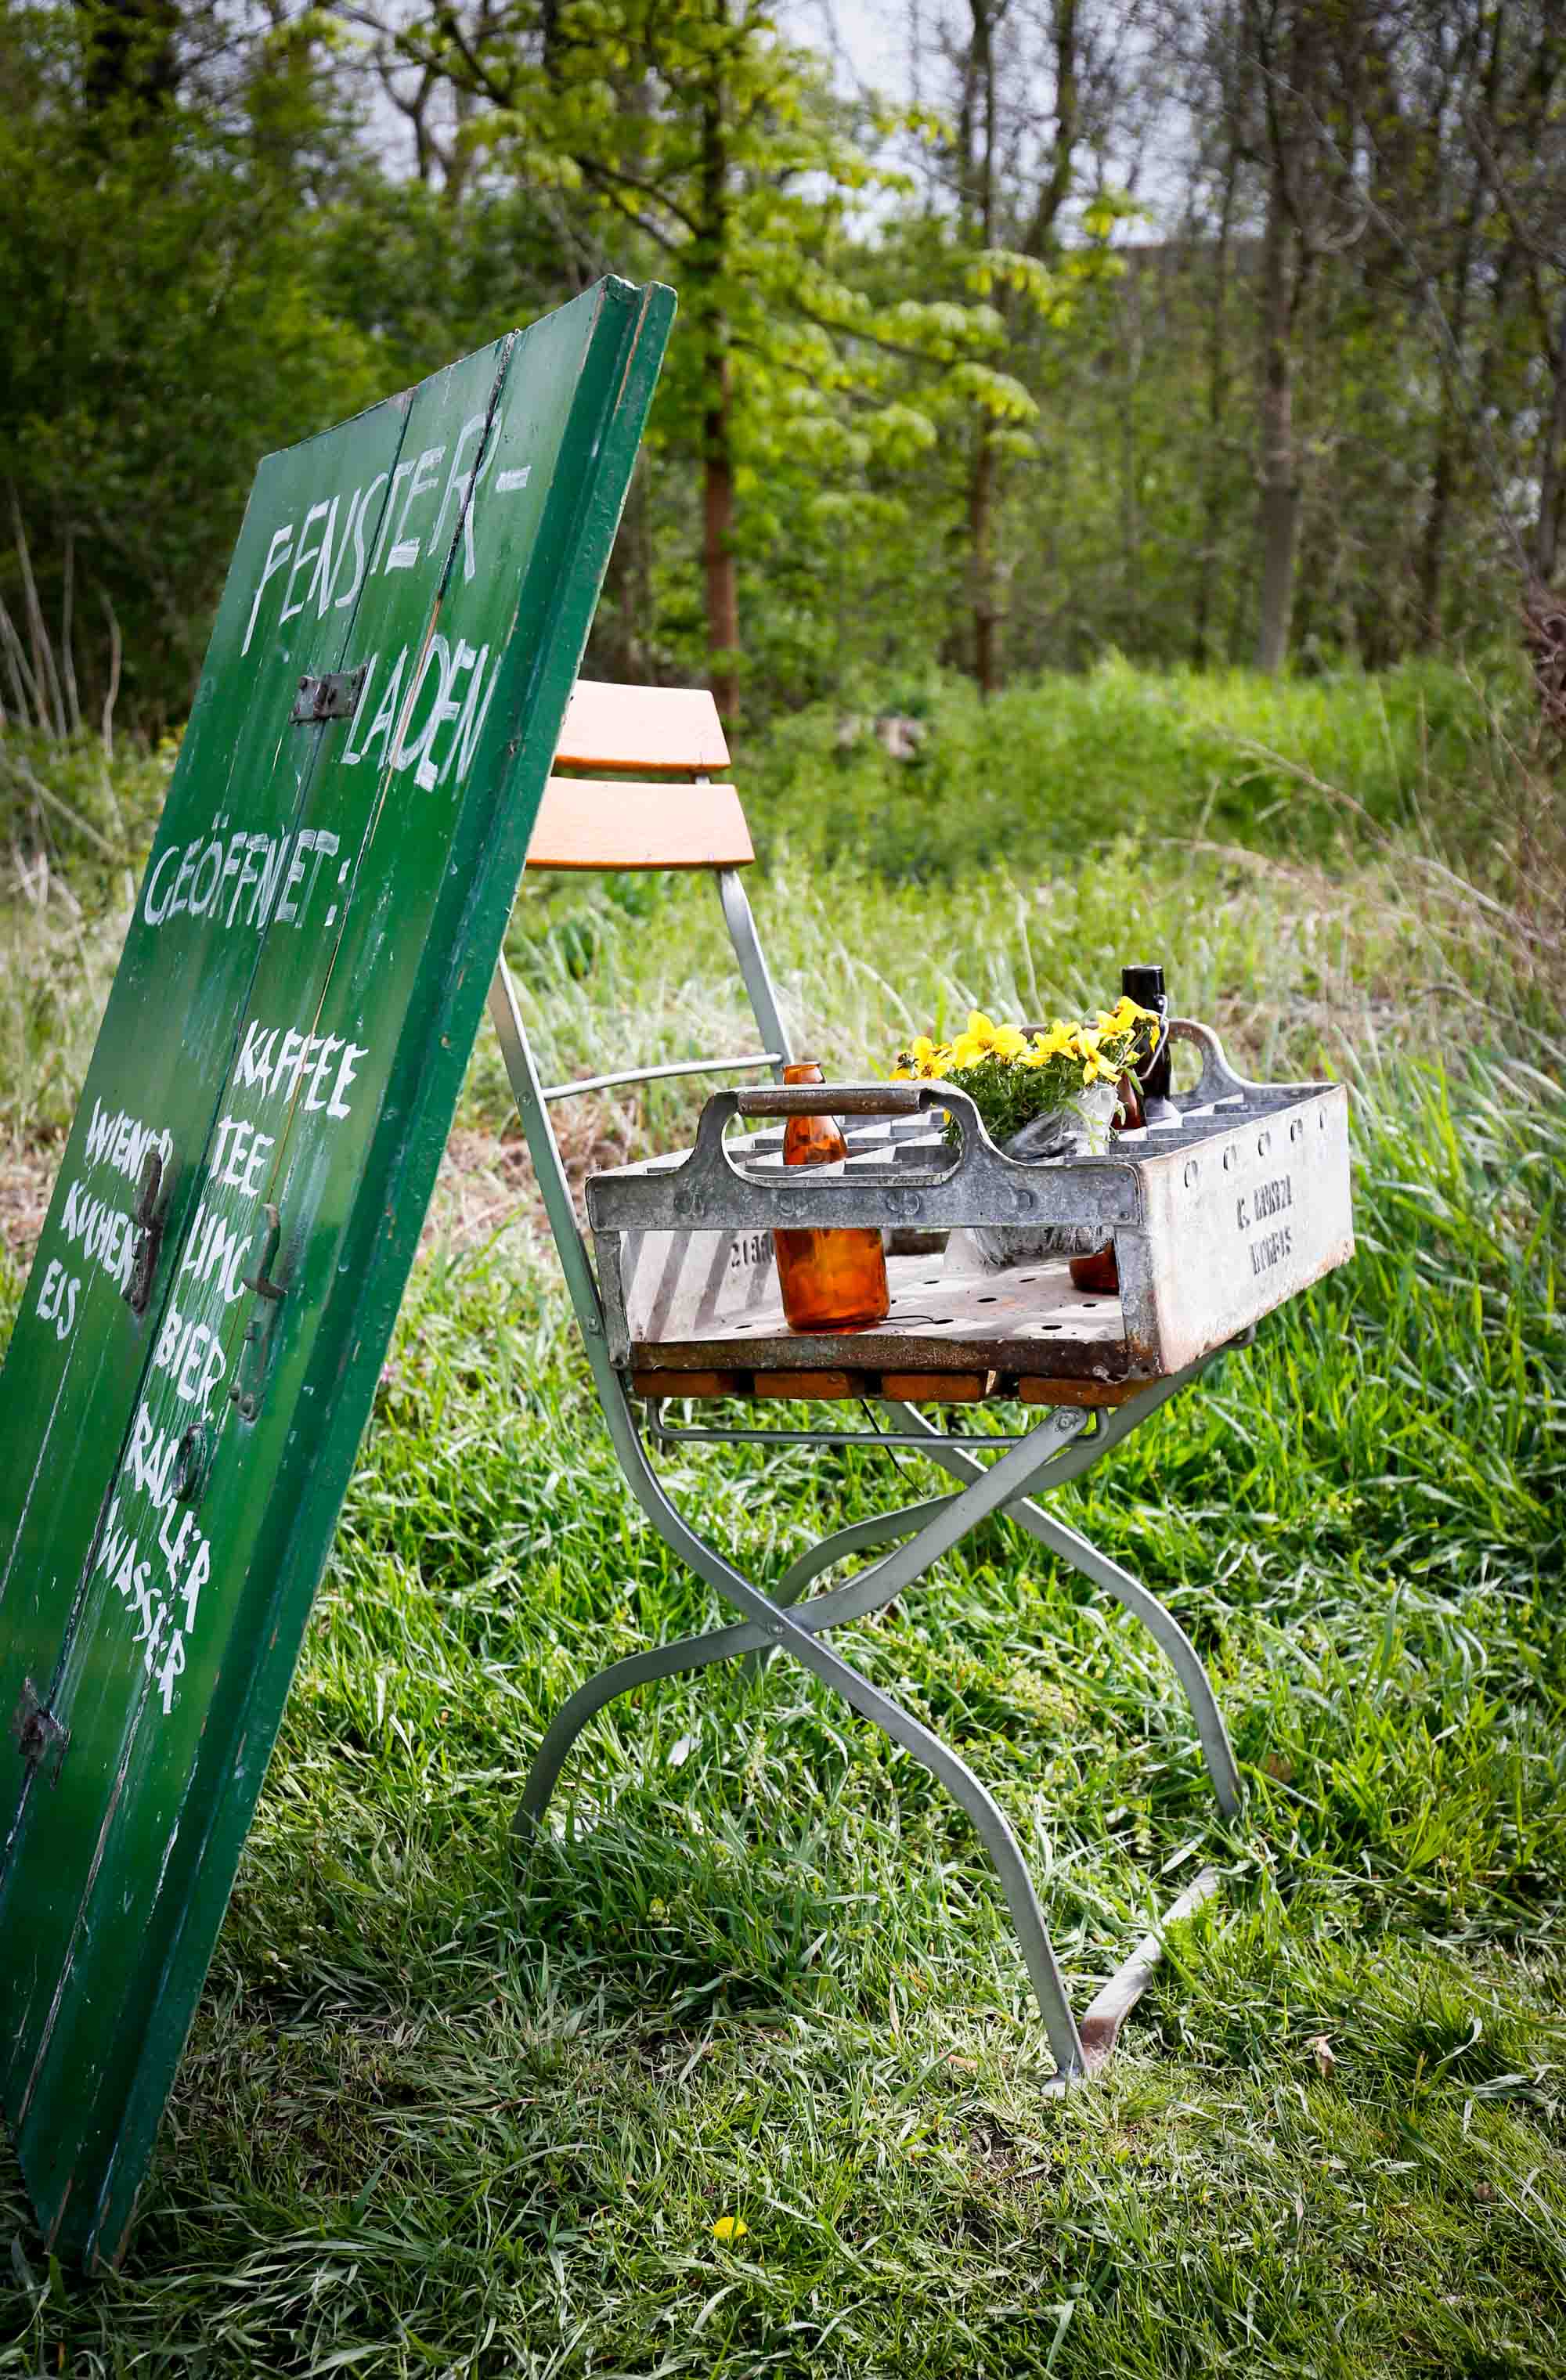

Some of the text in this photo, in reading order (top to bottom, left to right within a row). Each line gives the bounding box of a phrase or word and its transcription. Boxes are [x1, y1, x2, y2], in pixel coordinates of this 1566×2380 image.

[240, 407, 532, 658] FENSTER-
[340, 633, 502, 792] LADEN
[232, 1019, 369, 1120] KAFFEE
[209, 1115, 275, 1198] TEE
[60, 1178, 144, 1296] KUCHEN
[36, 1258, 81, 1340] EIS
[155, 1303, 226, 1423] BIER
[96, 1496, 186, 1715] WASSER
